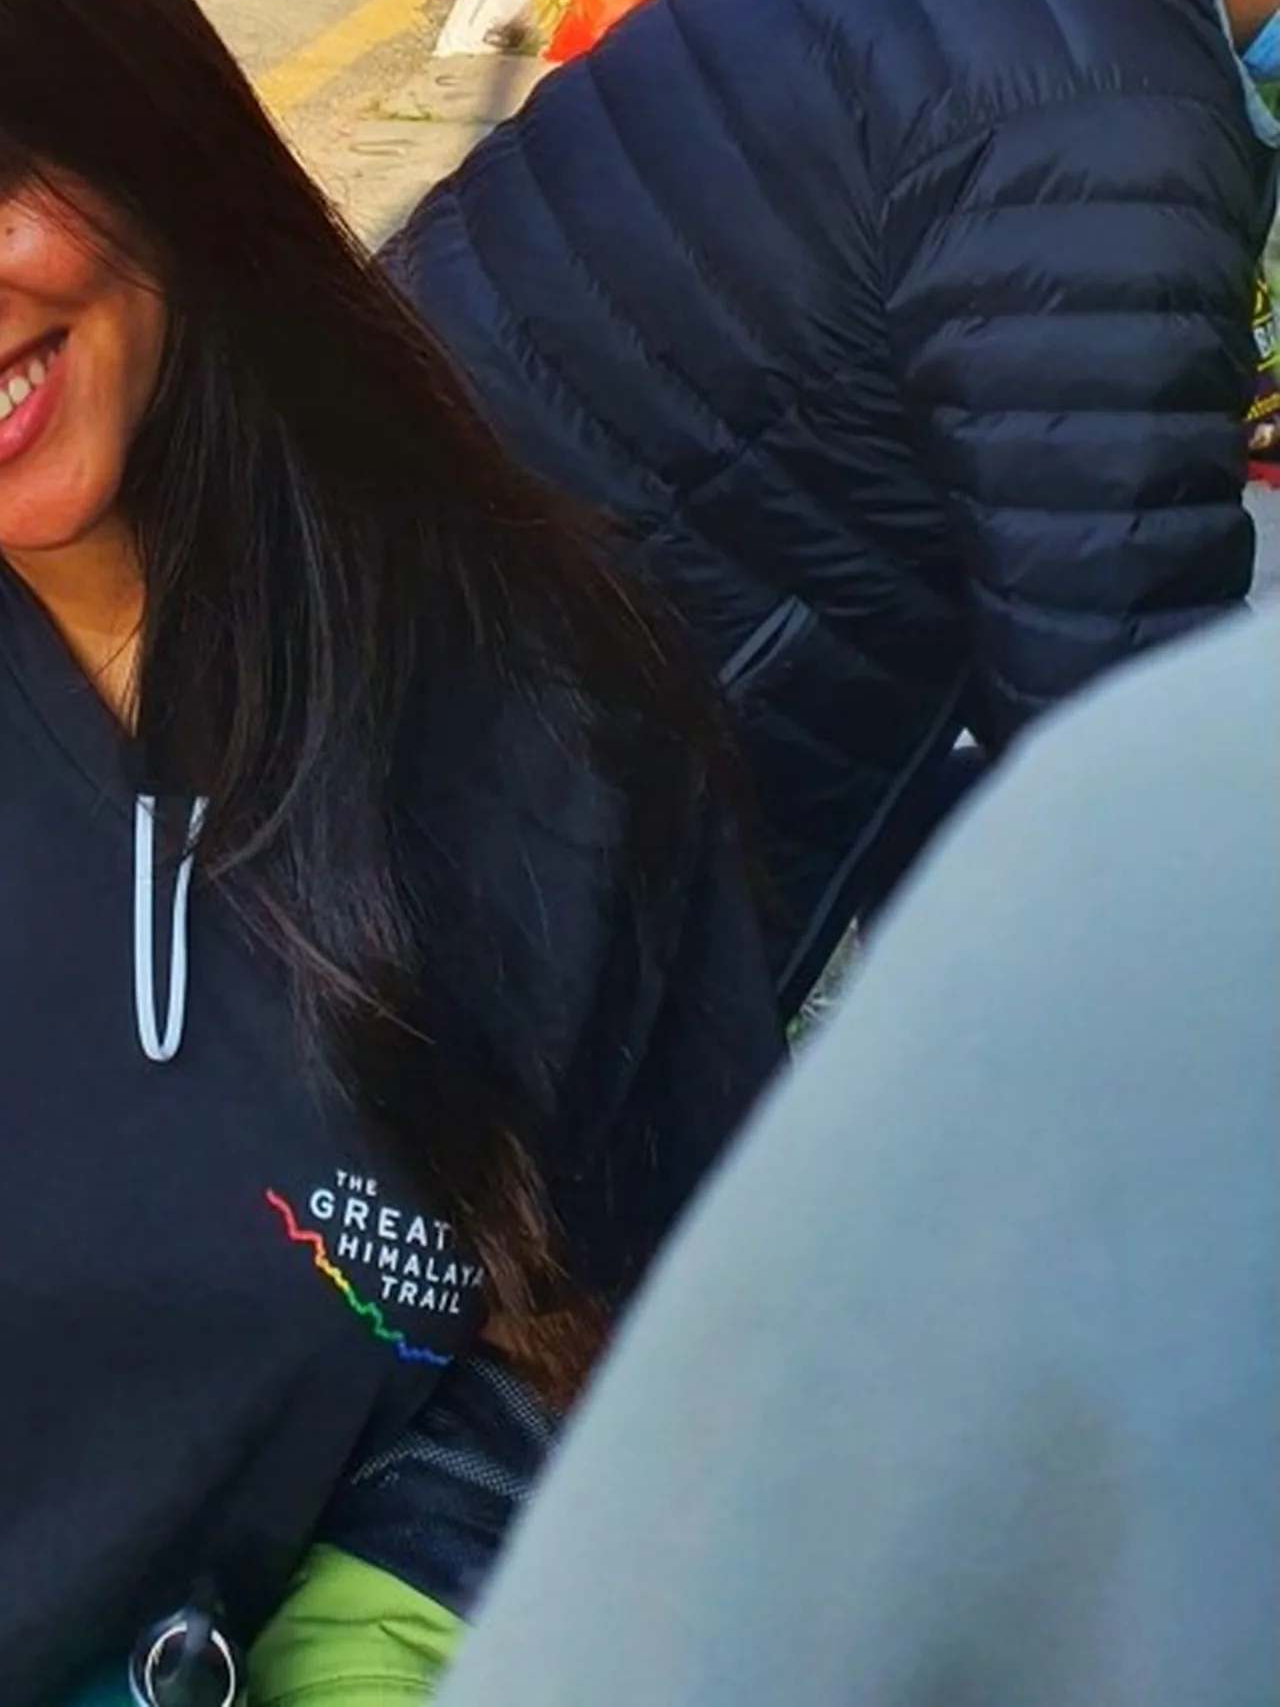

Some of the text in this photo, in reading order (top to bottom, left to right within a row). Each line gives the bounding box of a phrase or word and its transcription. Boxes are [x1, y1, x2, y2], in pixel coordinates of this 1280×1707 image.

[335, 1169, 378, 1197] THE
[309, 1188, 453, 1251] GREAT
[381, 1275, 461, 1315] TRAIL
